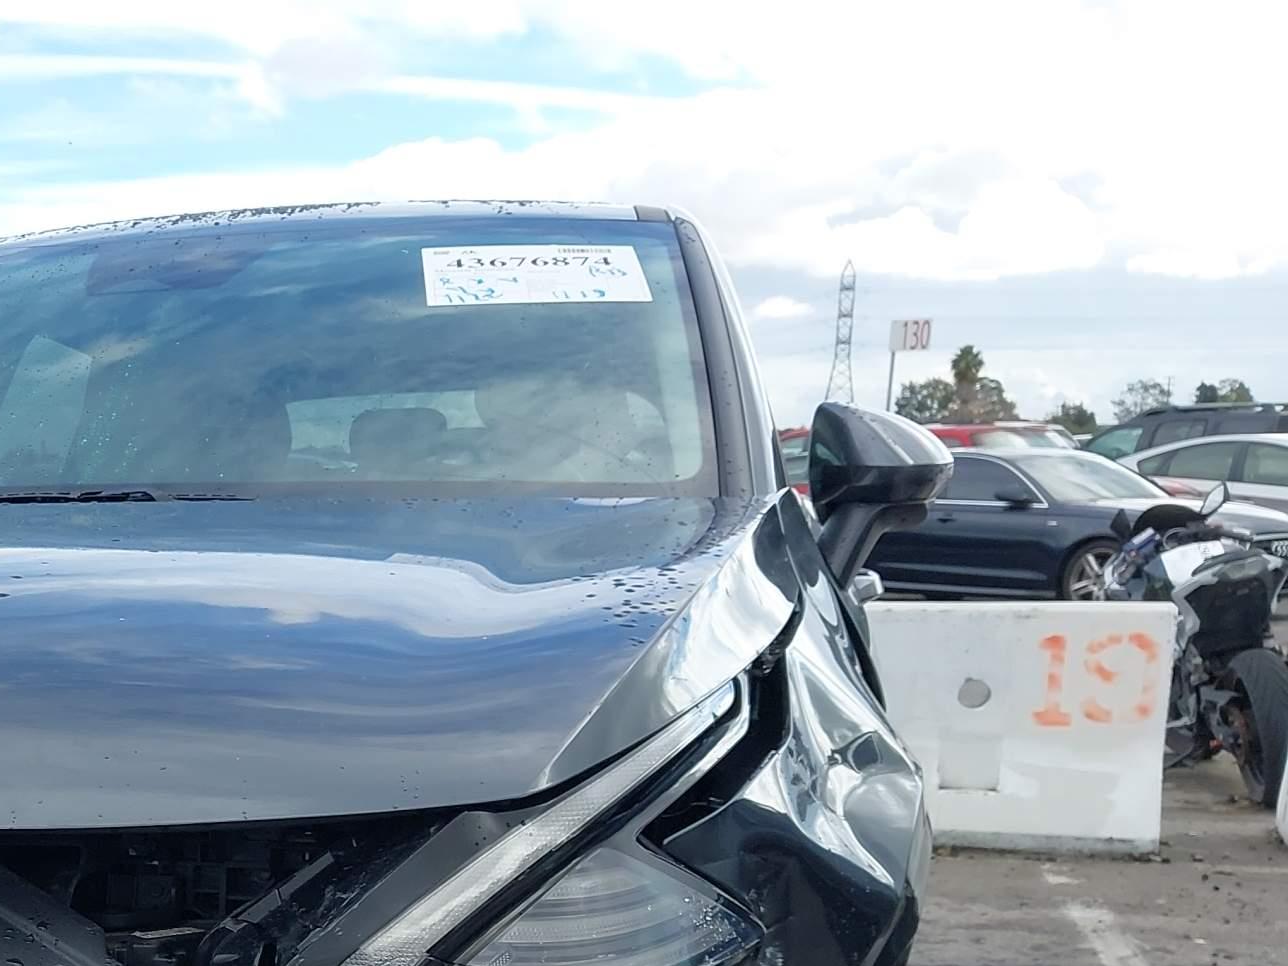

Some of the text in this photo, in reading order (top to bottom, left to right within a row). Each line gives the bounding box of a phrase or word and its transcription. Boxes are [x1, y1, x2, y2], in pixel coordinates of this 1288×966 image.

[446, 255, 613, 269] 43676874
[902, 319, 932, 351] 130
[1030, 632, 1160, 727] 19
